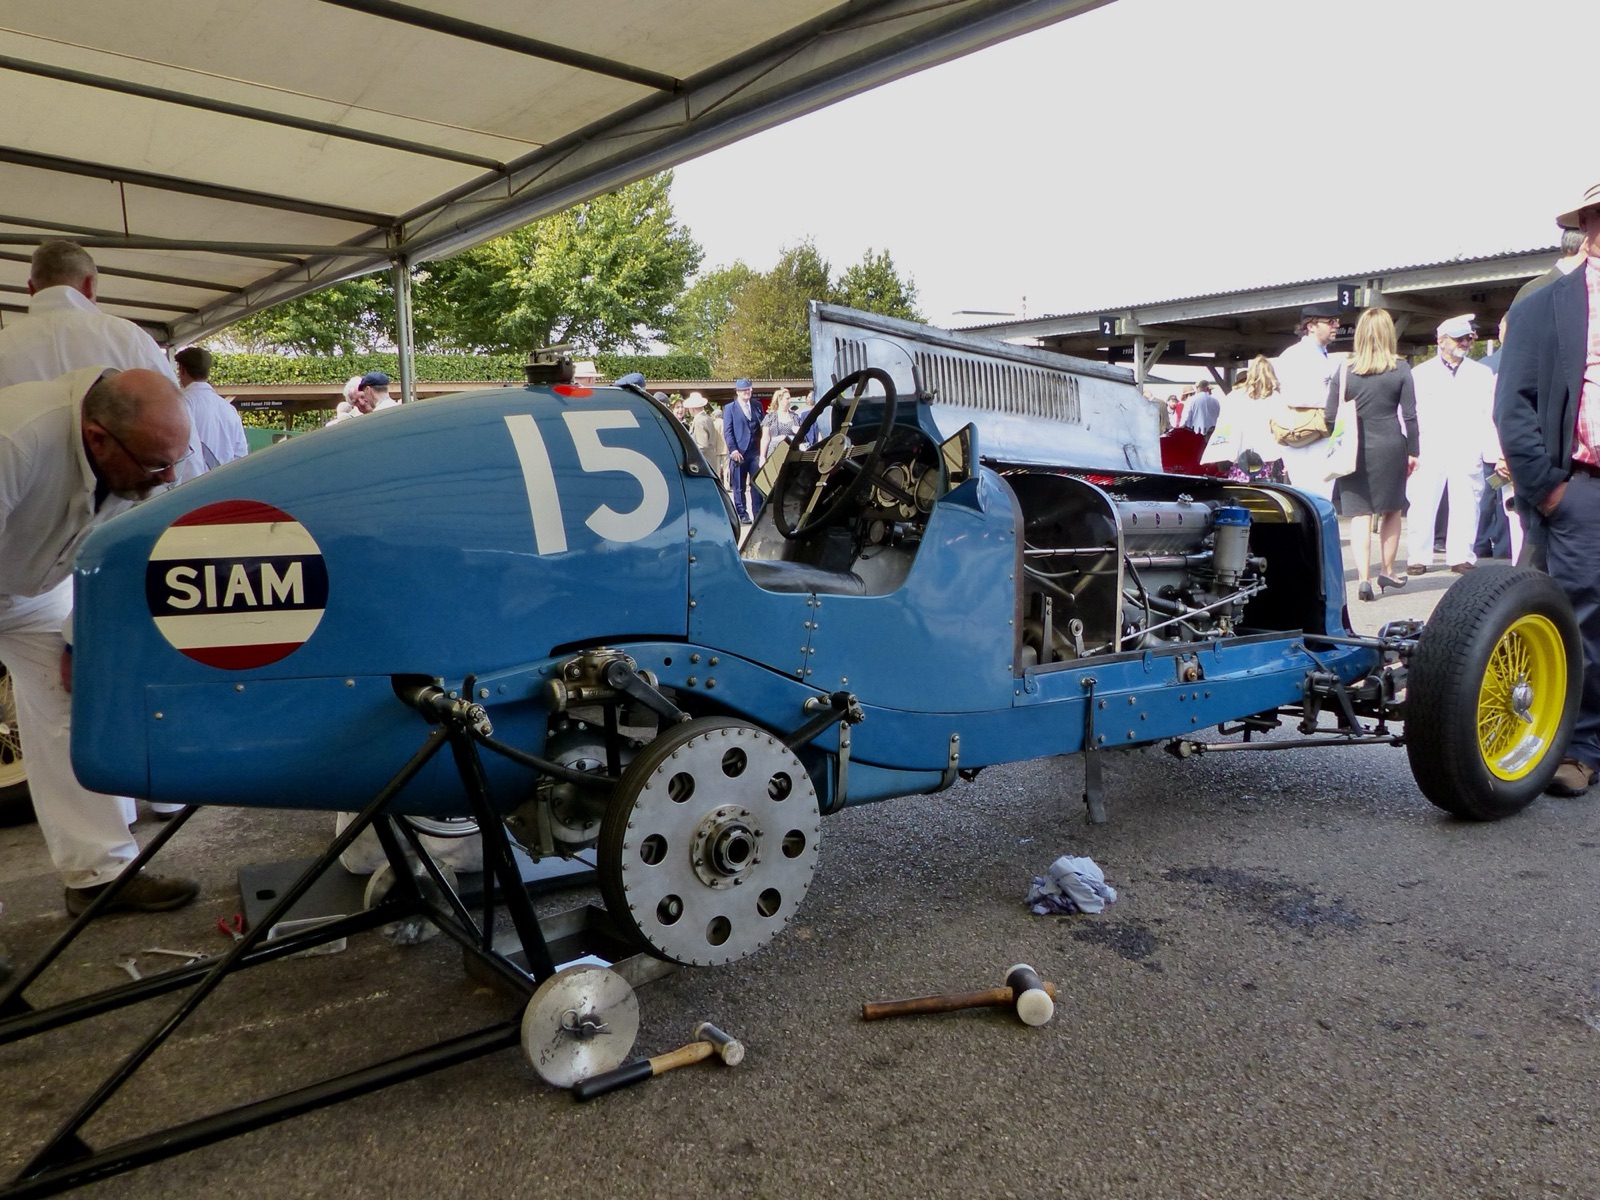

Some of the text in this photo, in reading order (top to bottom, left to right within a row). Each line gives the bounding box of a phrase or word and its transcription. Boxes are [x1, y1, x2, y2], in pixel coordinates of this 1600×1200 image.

[1342, 291, 1350, 306] 3
[1103, 321, 1111, 334] 2
[503, 409, 669, 556] 15
[165, 561, 305, 609] SIAM
